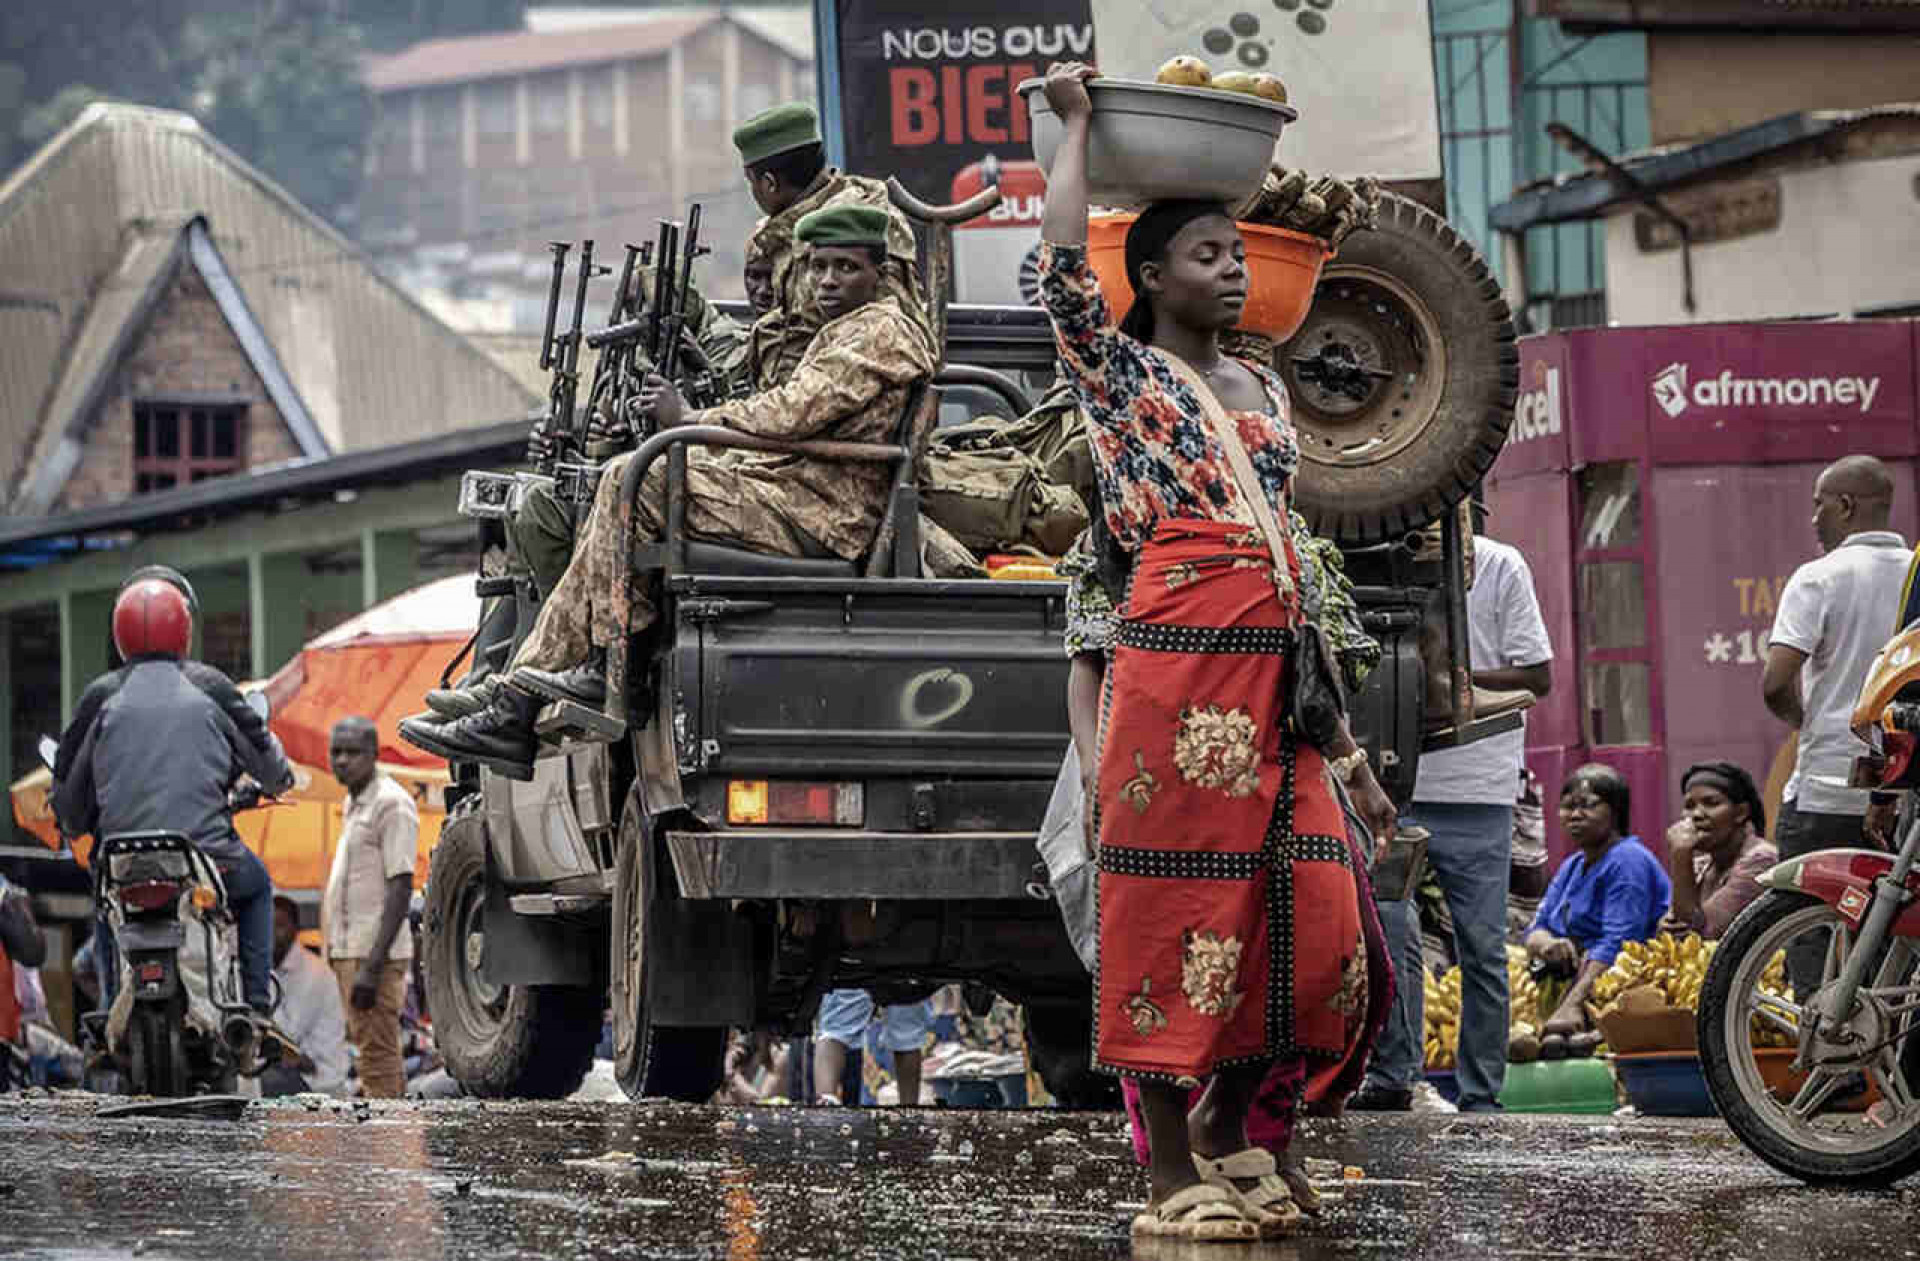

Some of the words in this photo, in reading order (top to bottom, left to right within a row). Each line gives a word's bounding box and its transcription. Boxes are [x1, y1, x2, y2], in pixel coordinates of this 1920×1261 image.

[882, 26, 997, 60] NOUS
[1003, 24, 1092, 57] OUV
[1733, 577, 1784, 617] TA
